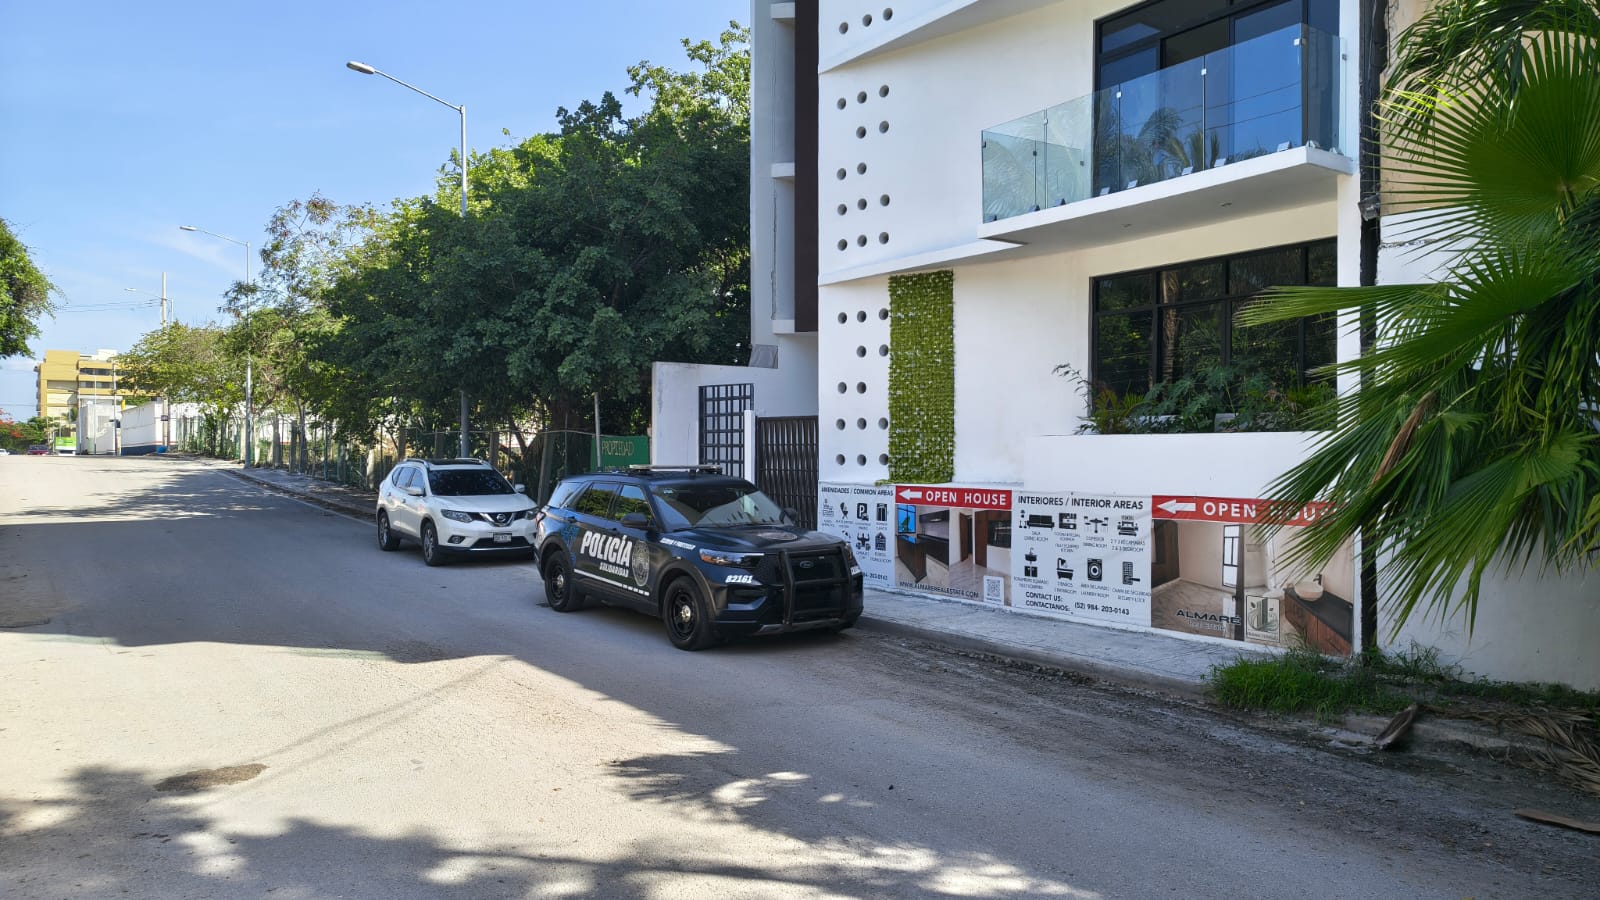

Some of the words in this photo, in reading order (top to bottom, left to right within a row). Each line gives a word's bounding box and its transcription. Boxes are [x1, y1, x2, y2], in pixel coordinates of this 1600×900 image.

[602, 440, 634, 456] PROPIEDAD
[926, 490, 957, 502] OPEN
[964, 493, 1006, 506] HOUSE
[1018, 496, 1064, 506] INTERIORES
[1065, 497, 1069, 506] /
[1071, 497, 1111, 508] INTERIOR
[1113, 500, 1144, 510] AREAS
[1203, 502, 1256, 518] OPEN
[580, 530, 633, 567] POLICÍA
[600, 562, 629, 578] SOLIDARIDAD
[1026, 592, 1052, 600] CONTACT
[1026, 600, 1070, 611] CONTACTANOS:
[1176, 609, 1241, 625] ALMARE
